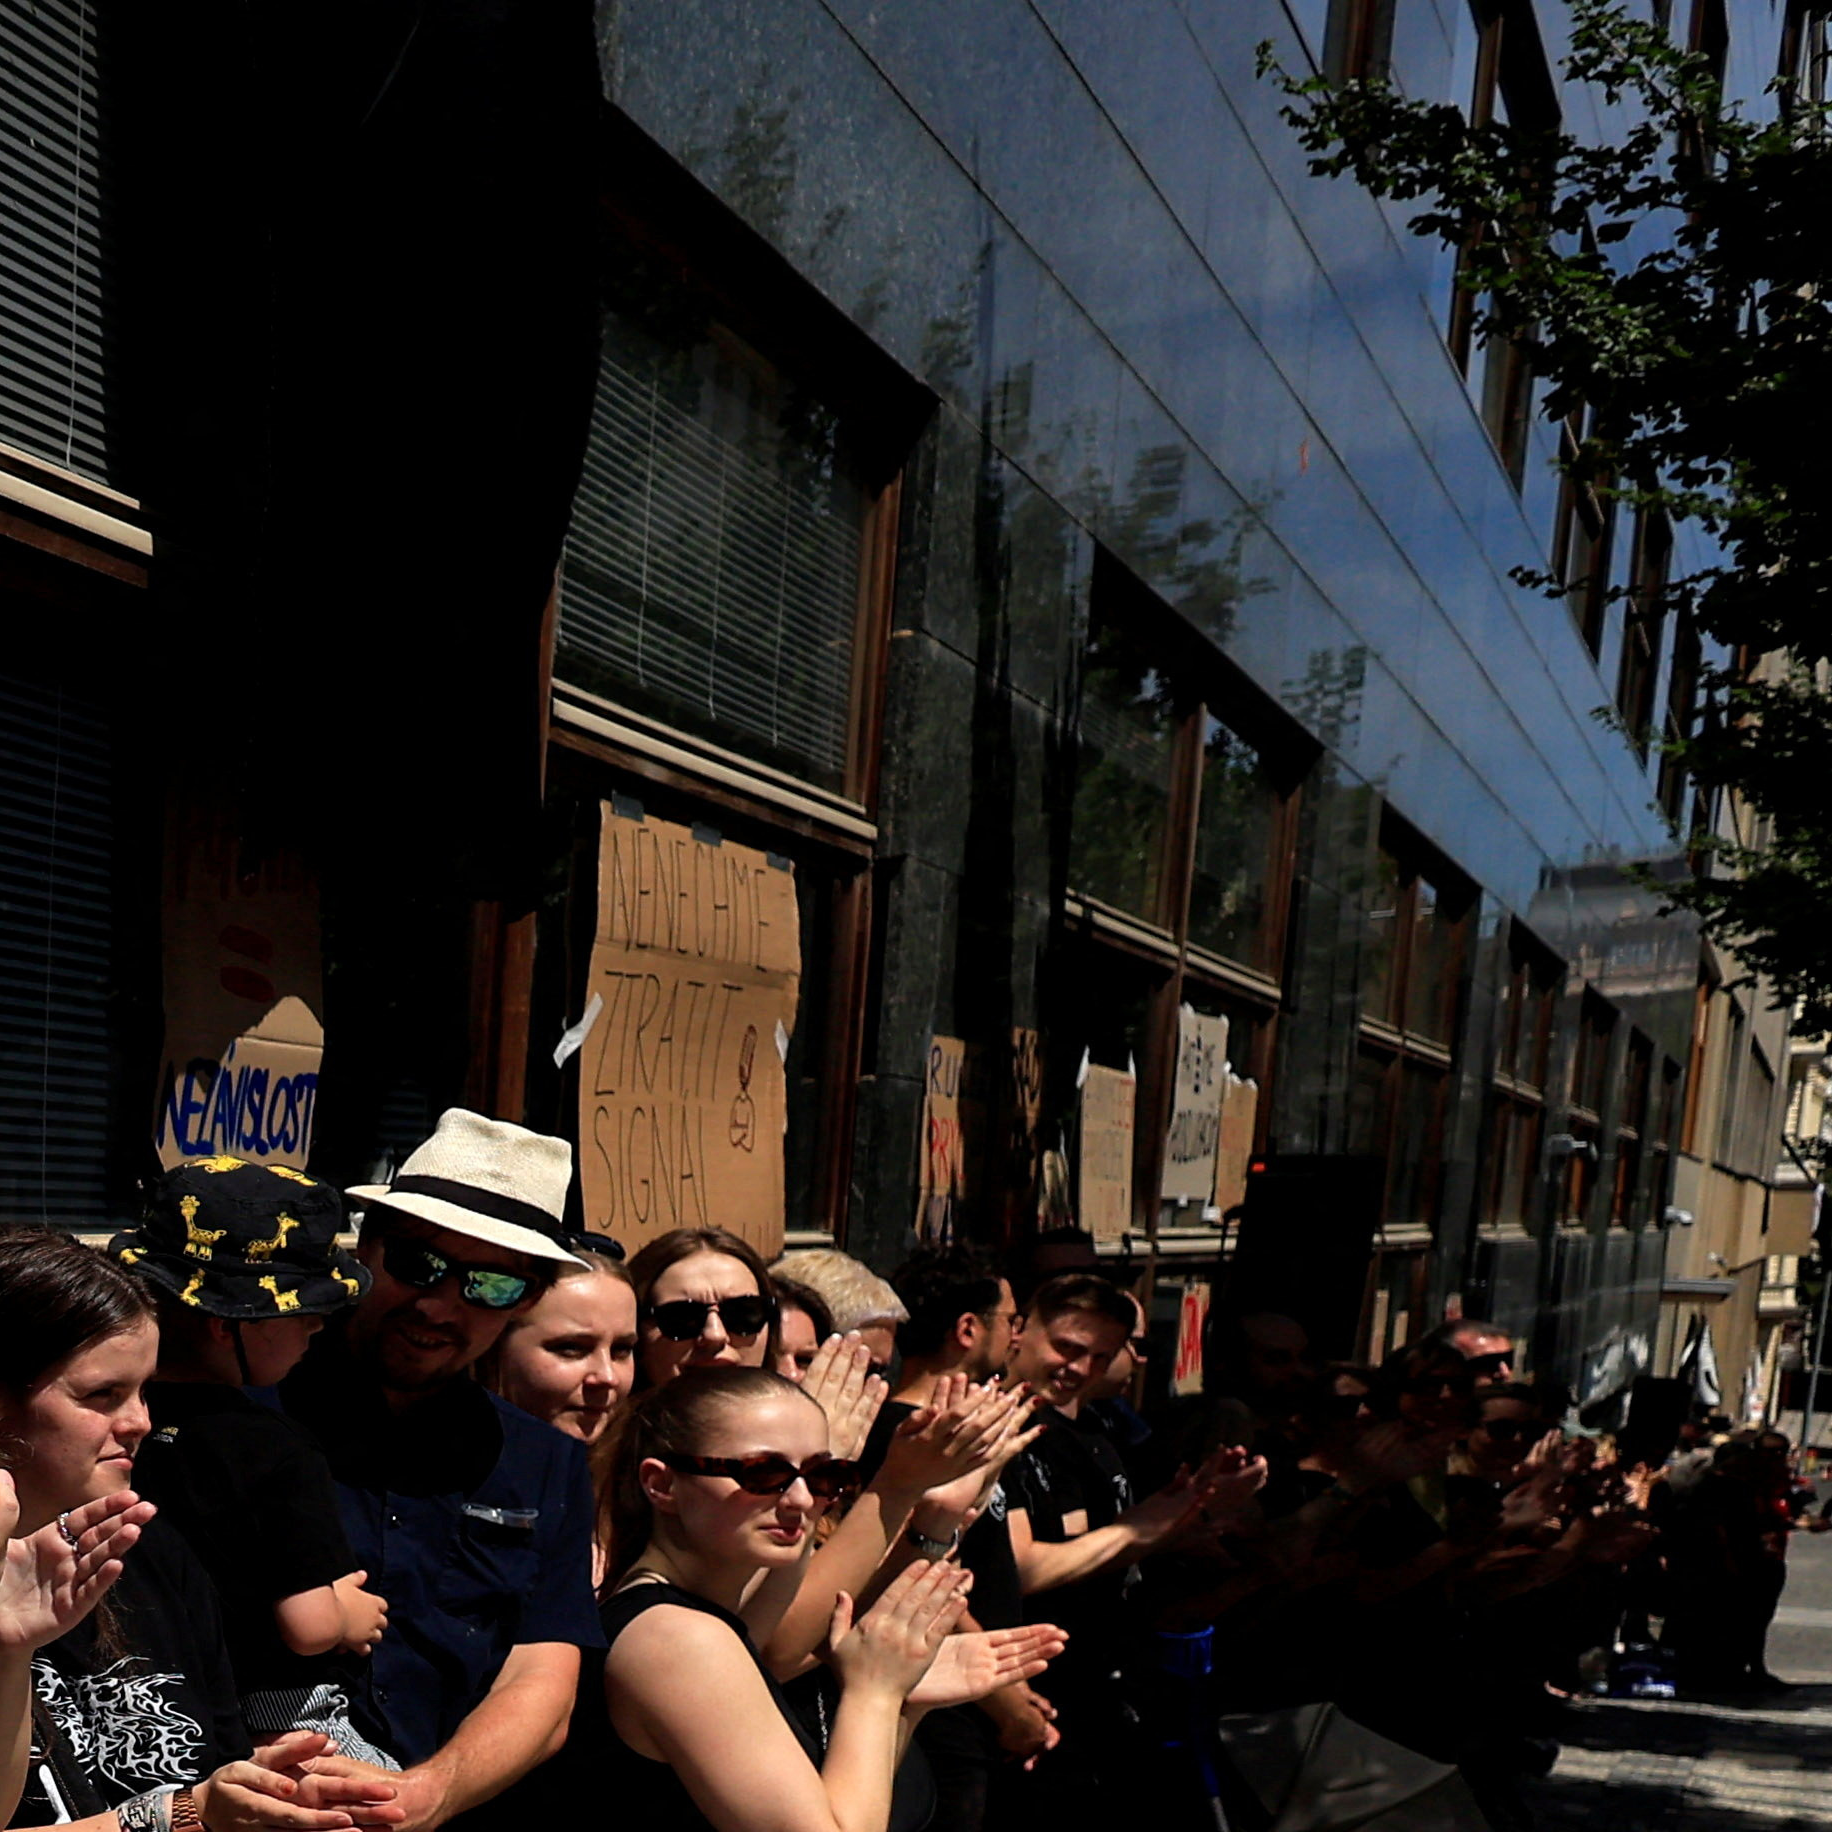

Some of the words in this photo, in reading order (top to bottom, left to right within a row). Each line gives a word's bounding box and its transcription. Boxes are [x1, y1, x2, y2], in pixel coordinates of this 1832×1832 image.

[609, 828, 769, 972] NENECHME
[156, 1039, 320, 1158] NEZÁVISLOST
[594, 970, 743, 1101] ZTRATIT
